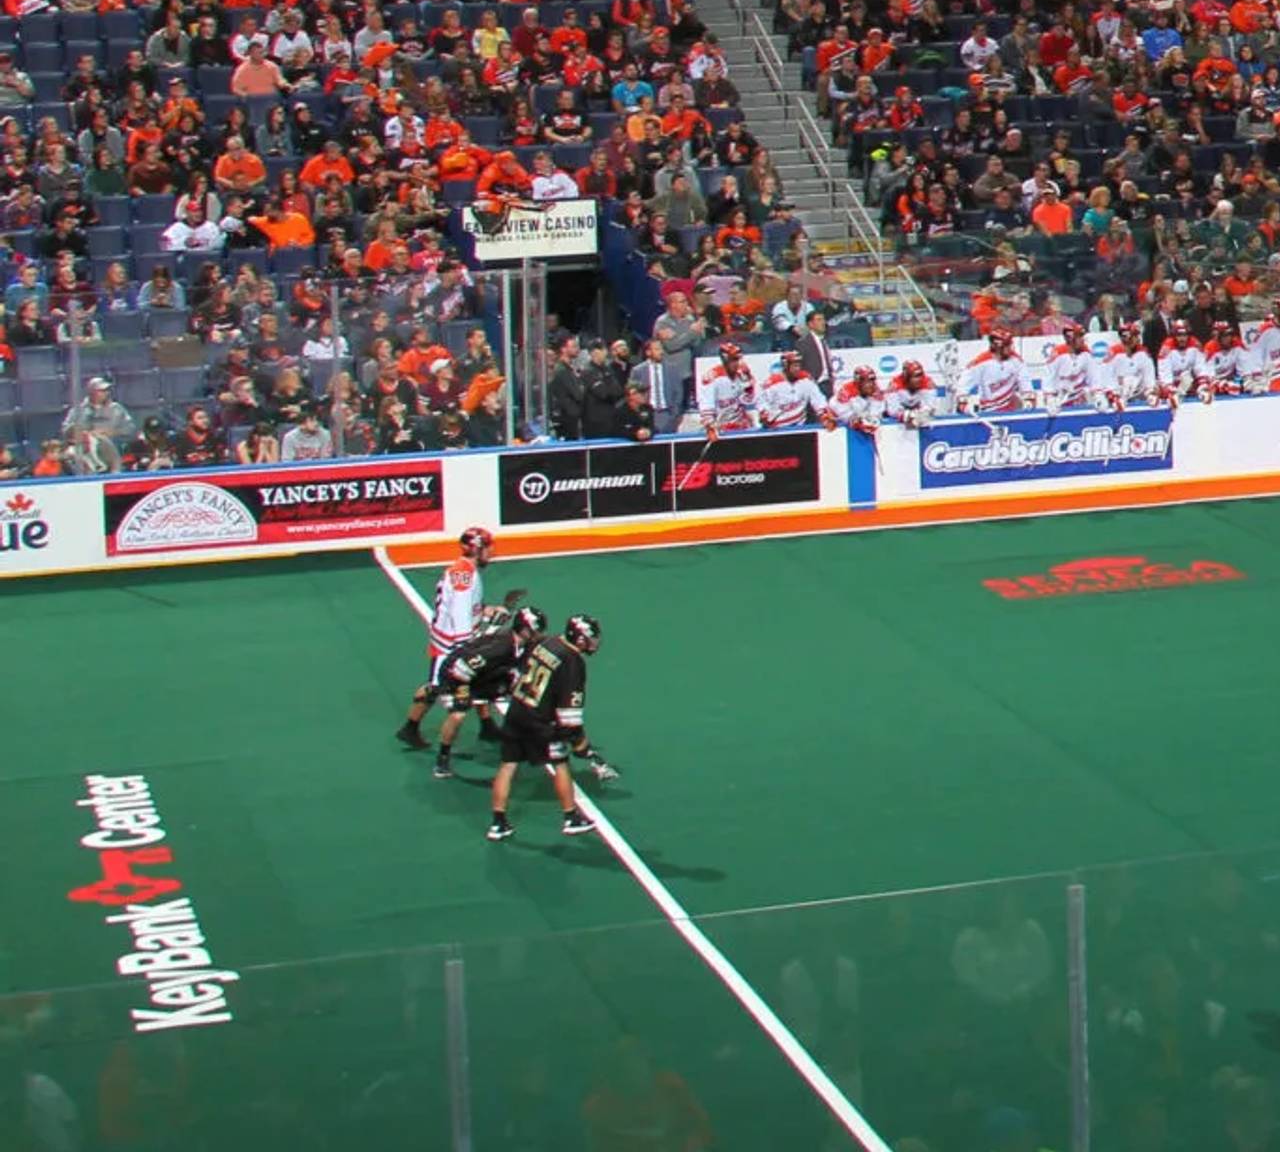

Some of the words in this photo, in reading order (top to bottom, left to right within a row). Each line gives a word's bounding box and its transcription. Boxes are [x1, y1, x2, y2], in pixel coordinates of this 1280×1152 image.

[545, 214, 596, 231] CASINO
[924, 434, 1047, 473] Carubba
[1049, 425, 1167, 461] Collision
[745, 457, 799, 471] balance
[257, 482, 358, 506] YANCEY'S
[363, 476, 433, 498] FANCY
[551, 474, 645, 493] WARRIOR
[717, 473, 765, 486] lacrosse
[129, 489, 193, 534] YANCEY'S
[200, 490, 245, 527] FANCY
[286, 516, 406, 533] www.yanceysfancy.com
[76, 774, 166, 849] Center
[106, 897, 240, 1032] KeyBank
